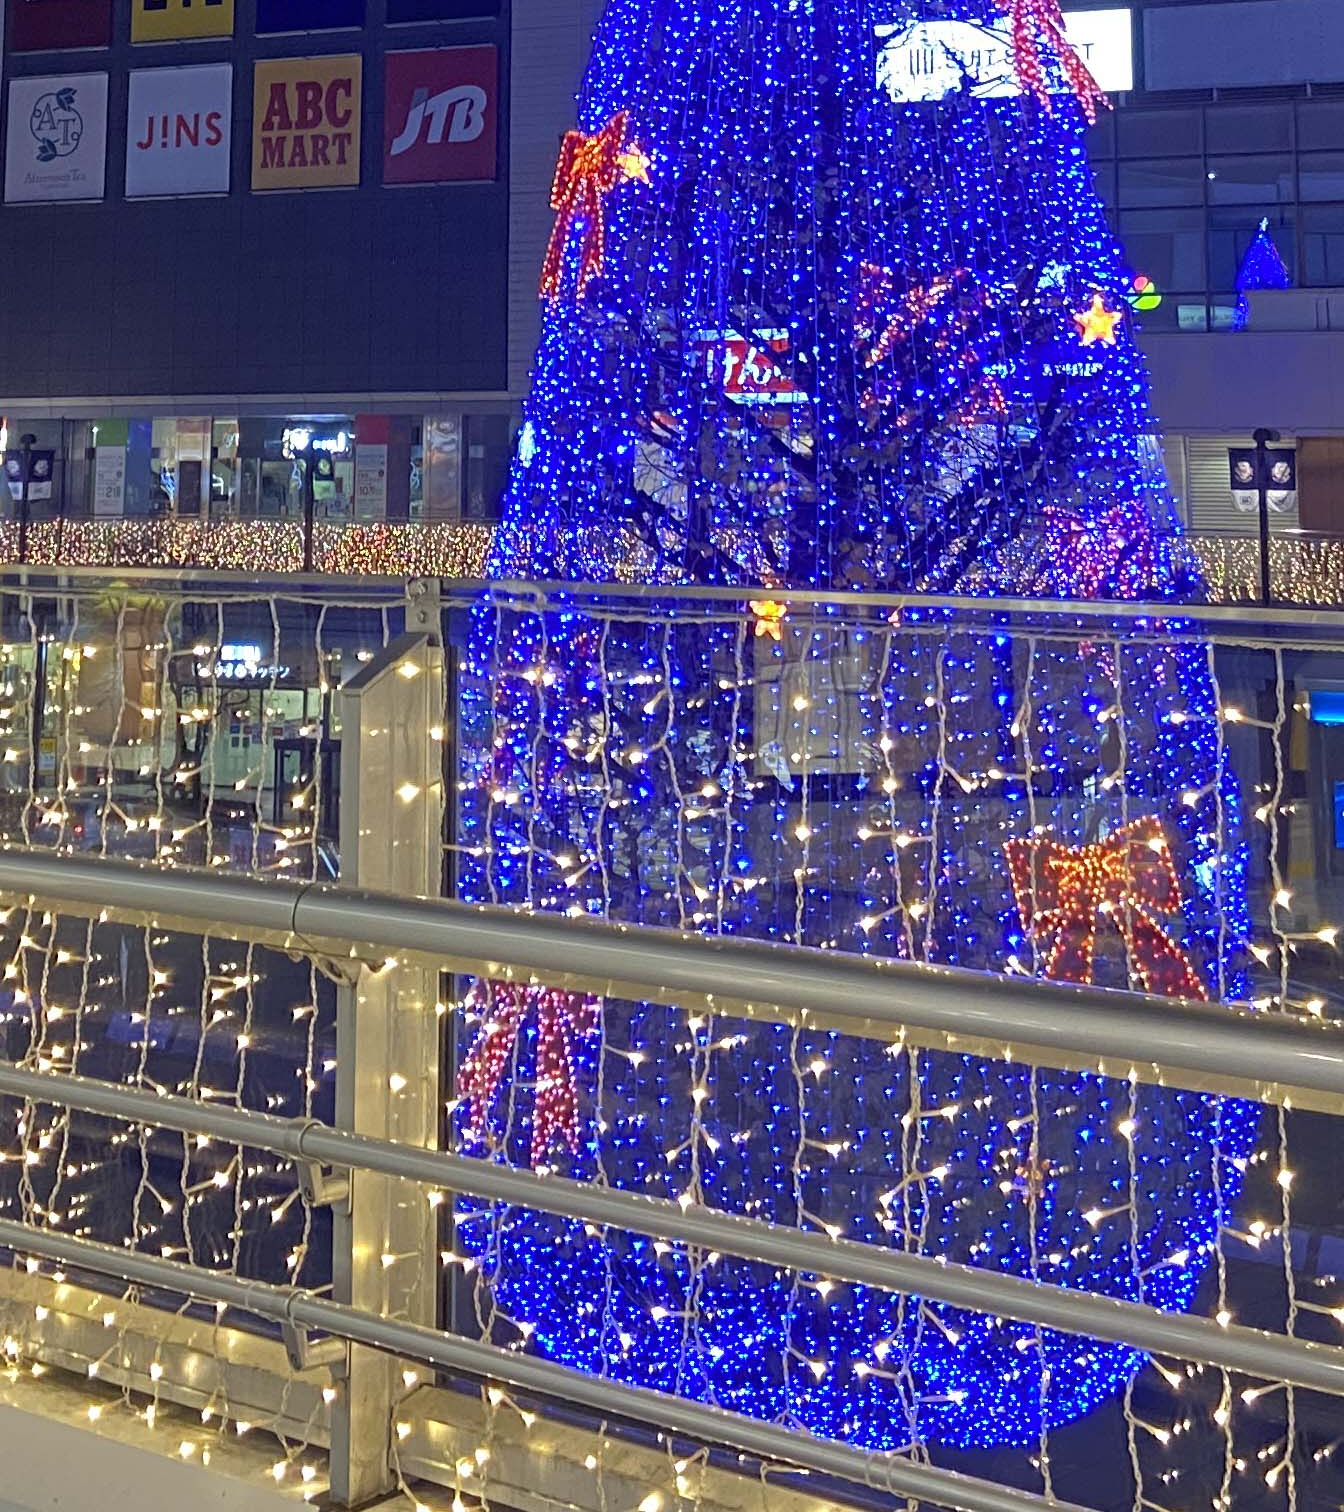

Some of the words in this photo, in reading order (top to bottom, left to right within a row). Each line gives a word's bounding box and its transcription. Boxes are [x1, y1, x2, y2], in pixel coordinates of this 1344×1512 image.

[261, 78, 353, 131] ABC
[390, 84, 488, 156] JTB
[260, 134, 353, 169] MART
